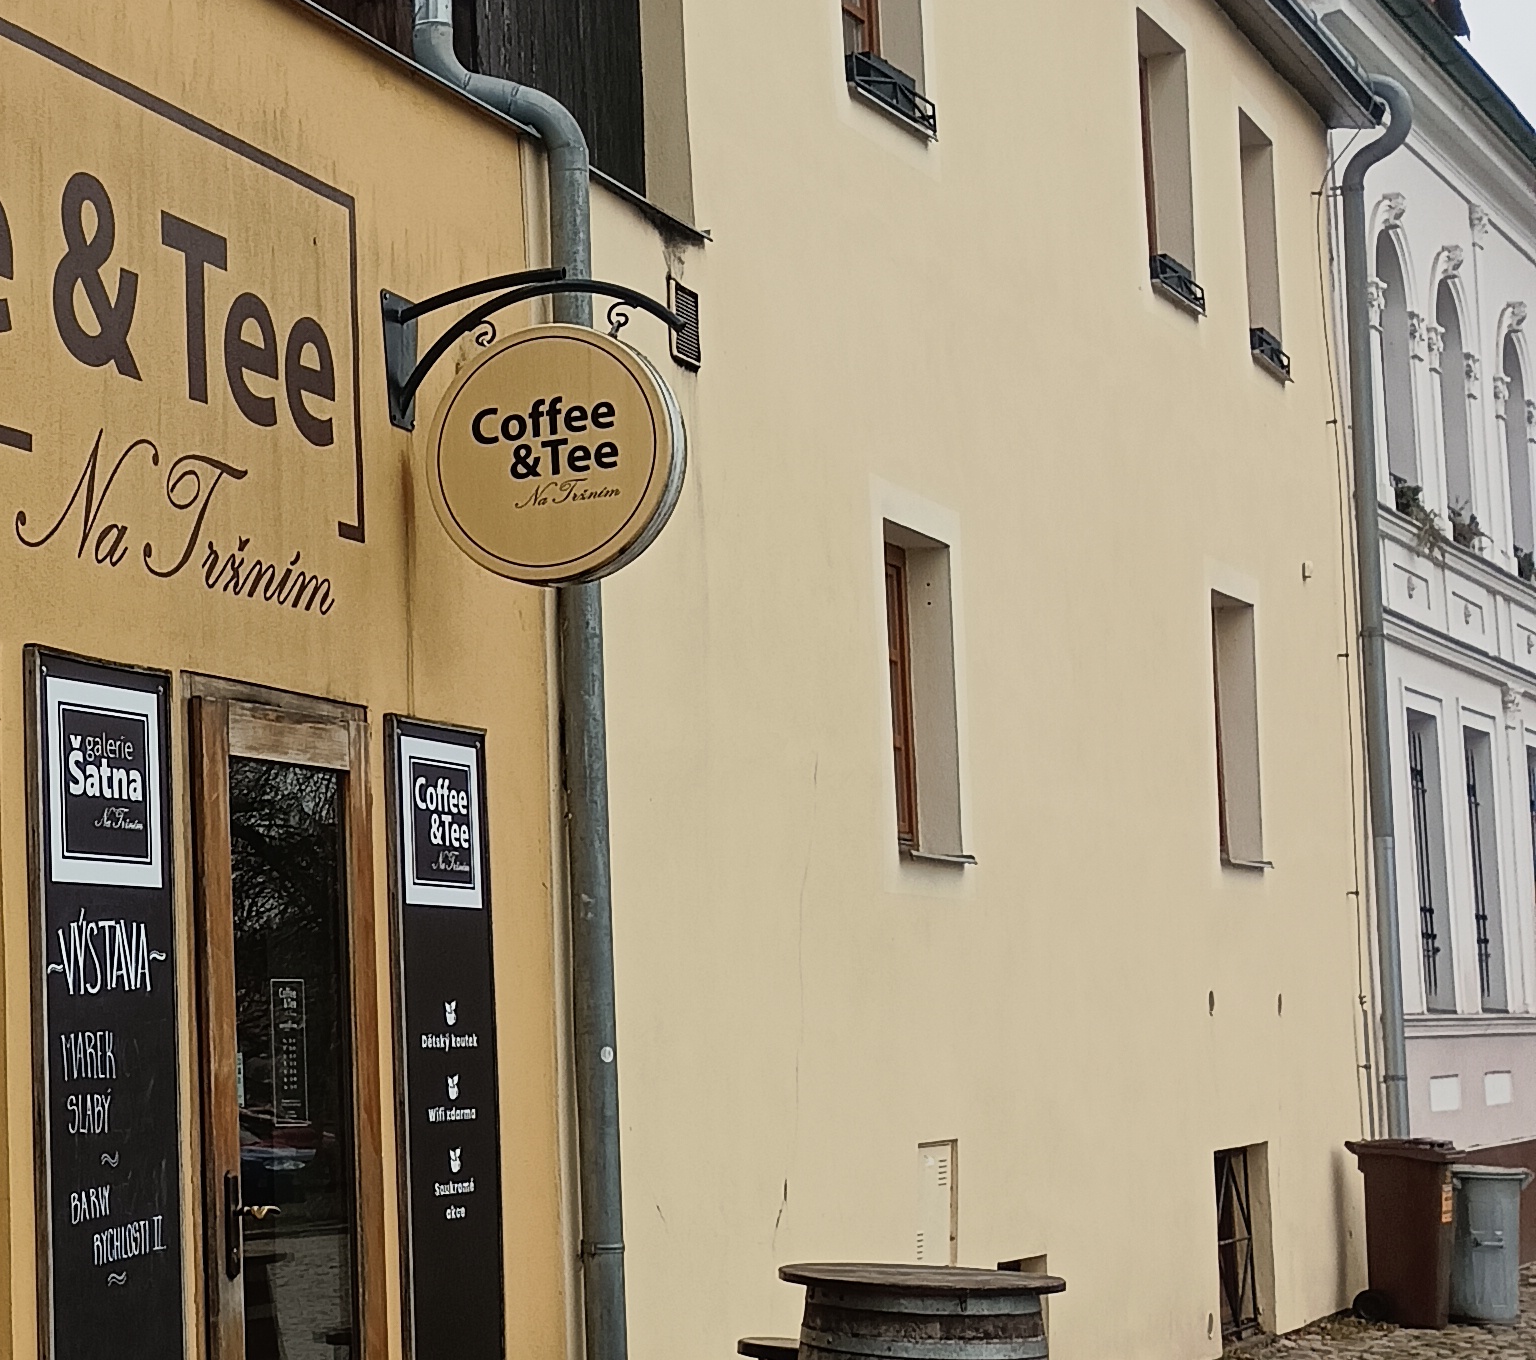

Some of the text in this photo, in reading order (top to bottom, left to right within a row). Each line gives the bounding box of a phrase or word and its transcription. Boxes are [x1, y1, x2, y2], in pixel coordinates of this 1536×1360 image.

[53, 171, 142, 382] &
[161, 210, 335, 447] Tee
[472, 396, 616, 445] Coffee
[510, 438, 619, 479] &Tee
[515, 478, 621, 508] Na Tržním
[16, 428, 335, 616] Na Tržním
[85, 732, 134, 762] galerie
[68, 734, 143, 802] Šatna
[415, 777, 468, 815] Coffee
[430, 814, 470, 849] &Tee
[58, 908, 152, 995] VÝSTAVA
[60, 1030, 117, 1081] MAREK
[422, 1033, 478, 1052] Dětský koutek
[67, 1088, 112, 1134] SLABÝ
[428, 1106, 476, 1123] Wifi zdarma
[71, 1184, 111, 1225] BARVY
[434, 1178, 475, 1196] Soukromé
[93, 1220, 150, 1267] RYCHLOSTI
